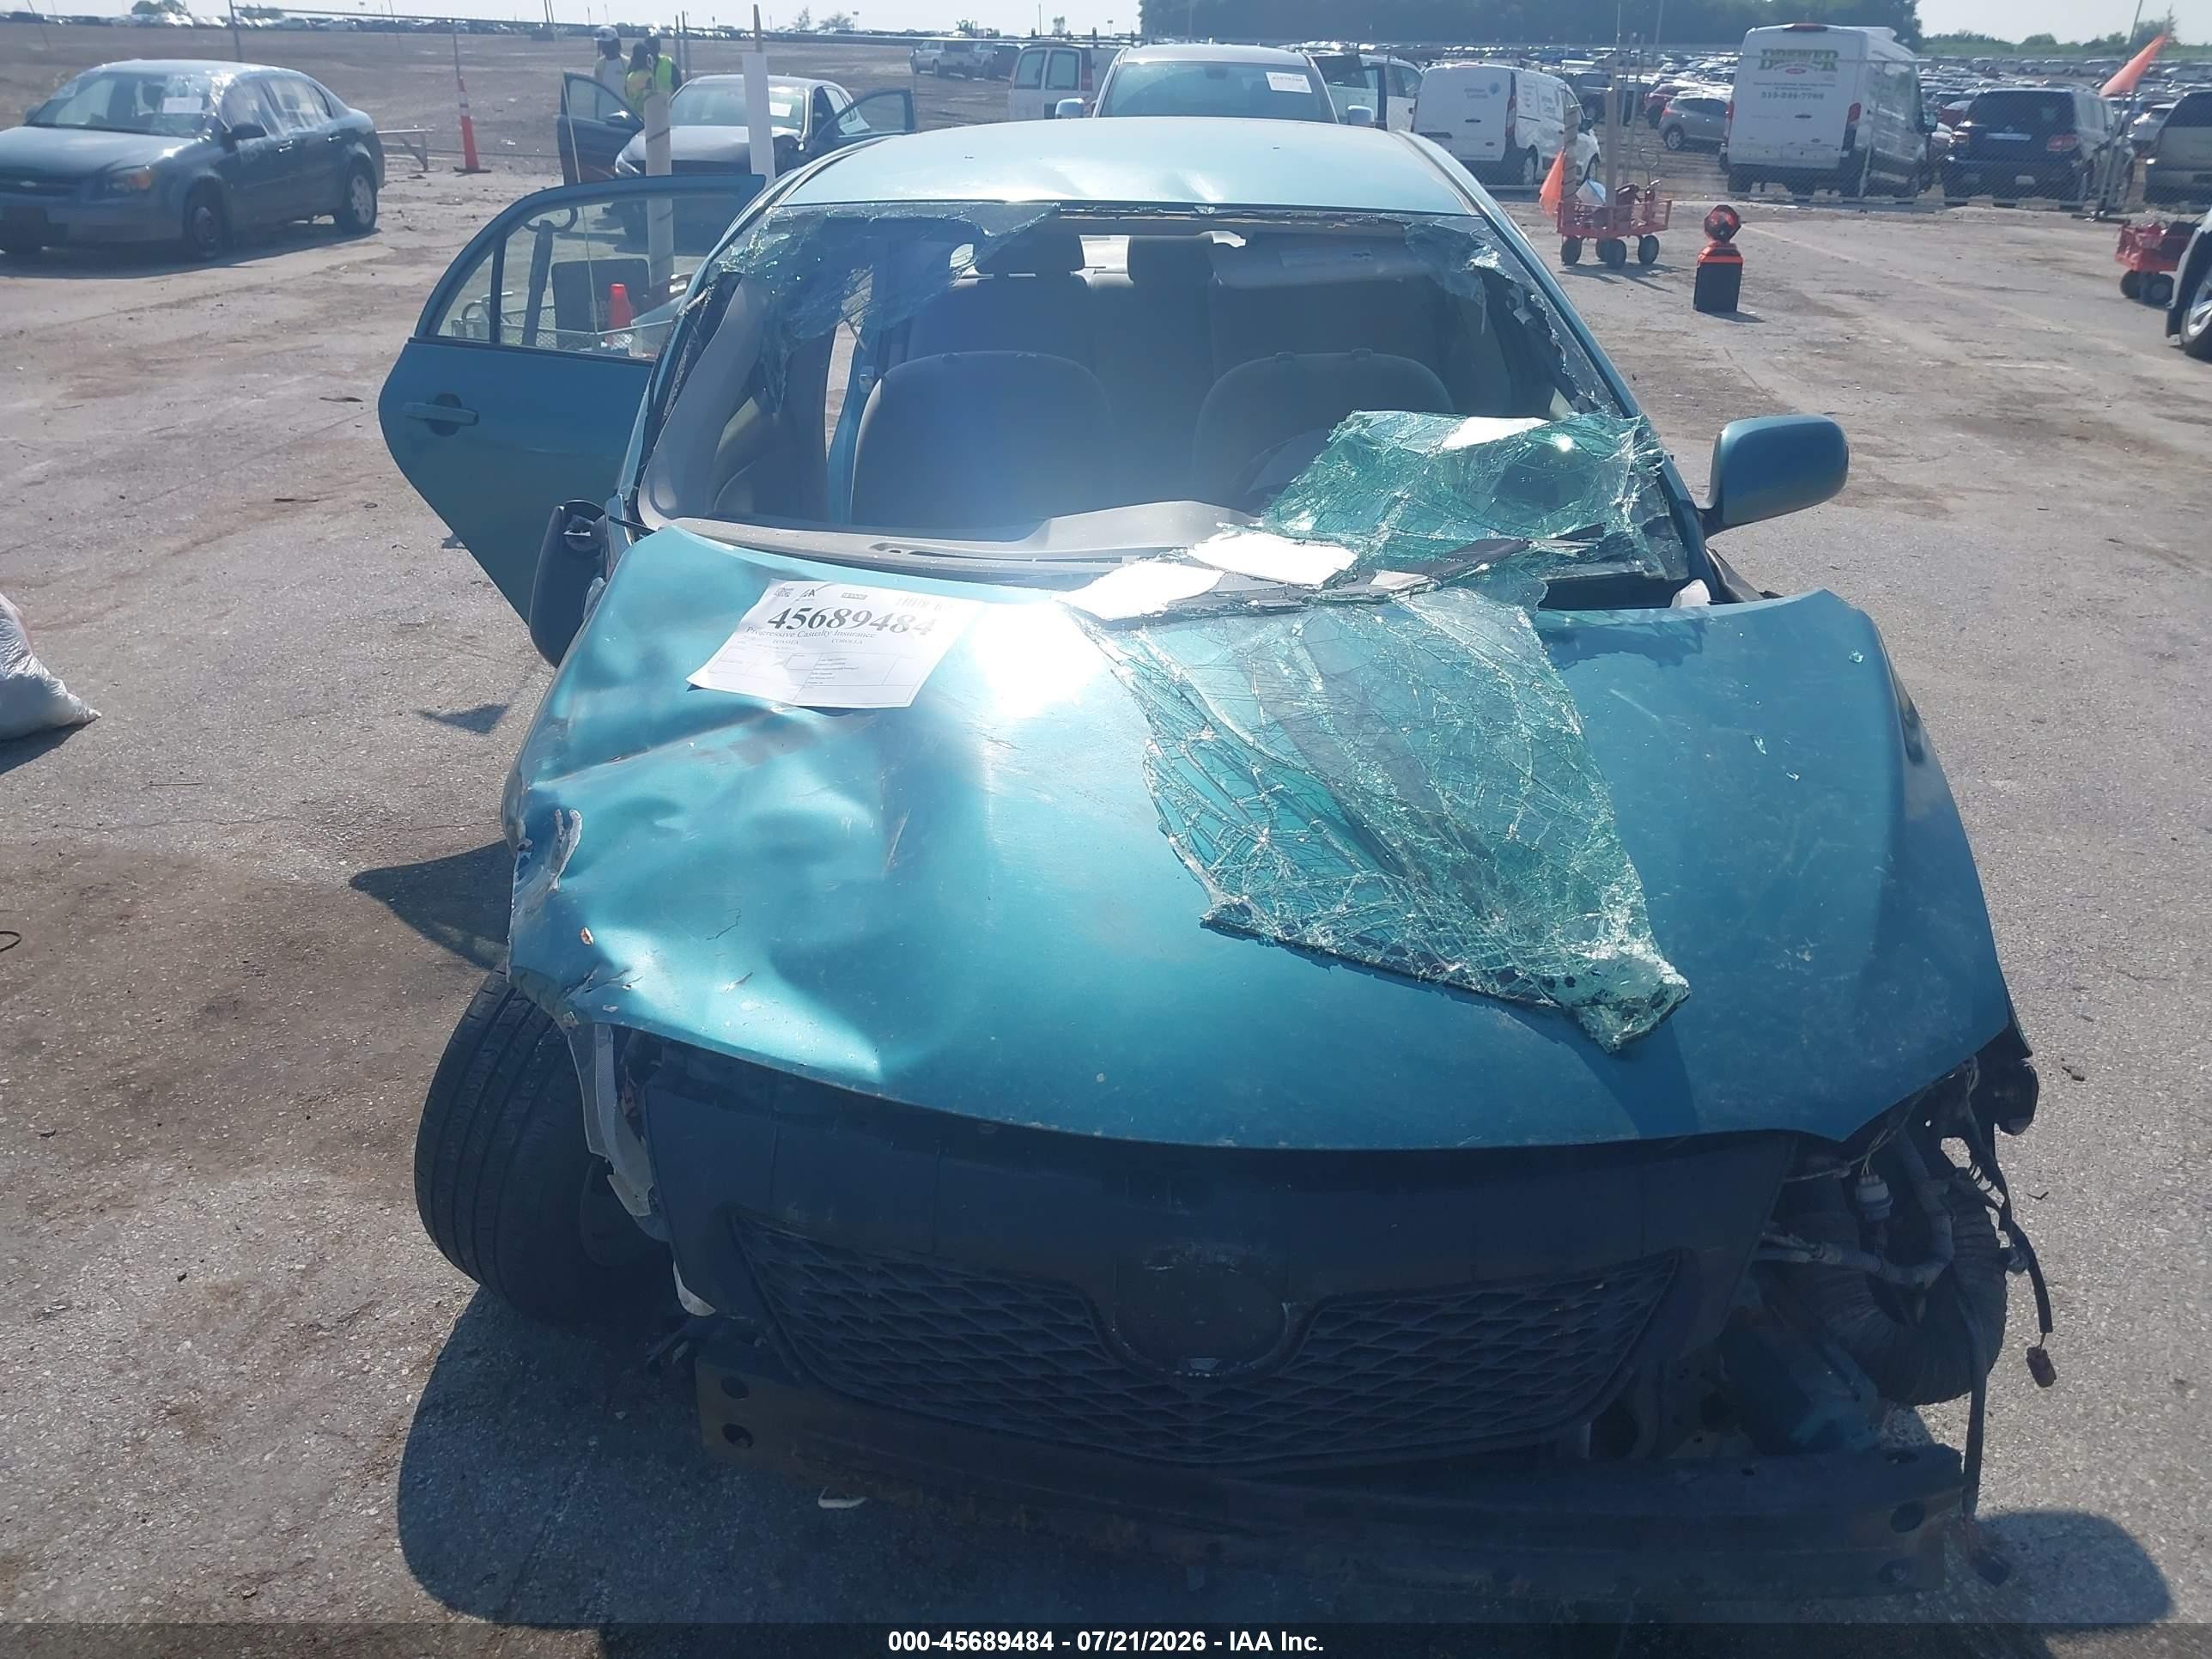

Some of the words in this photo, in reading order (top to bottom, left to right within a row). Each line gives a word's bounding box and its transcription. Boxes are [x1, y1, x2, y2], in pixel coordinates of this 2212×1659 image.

[767, 606, 936, 636] 45689484
[745, 626, 796, 639] Progressive
[797, 629, 831, 640] Casualty
[834, 630, 877, 639] Insurance
